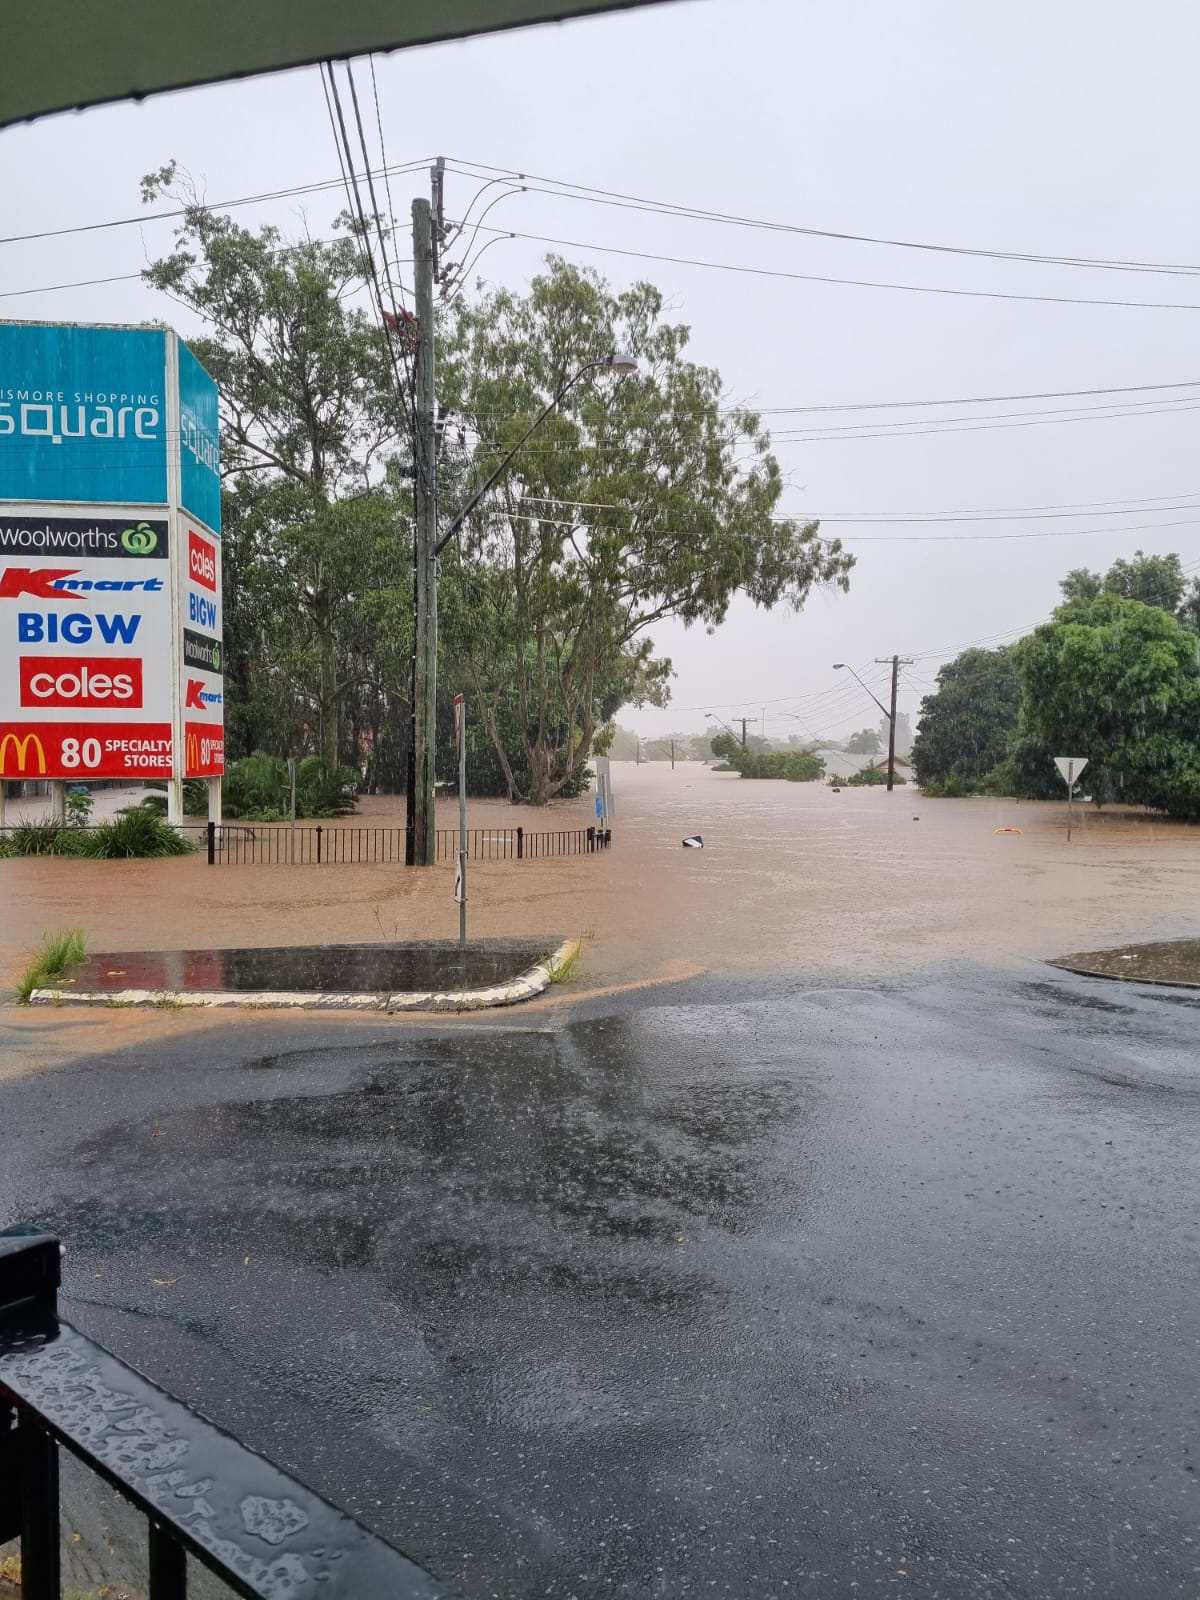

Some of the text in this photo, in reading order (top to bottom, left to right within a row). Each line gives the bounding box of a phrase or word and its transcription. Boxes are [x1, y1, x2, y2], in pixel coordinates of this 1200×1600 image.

[0, 389, 160, 405] ISMORE SHOPPING
[0, 525, 118, 548] Woolworths
[190, 547, 215, 582] coles
[30, 666, 134, 698] coles
[61, 738, 172, 768] 80 SPECIALTY
[124, 755, 172, 767] STORES
[201, 738, 210, 766] 80
